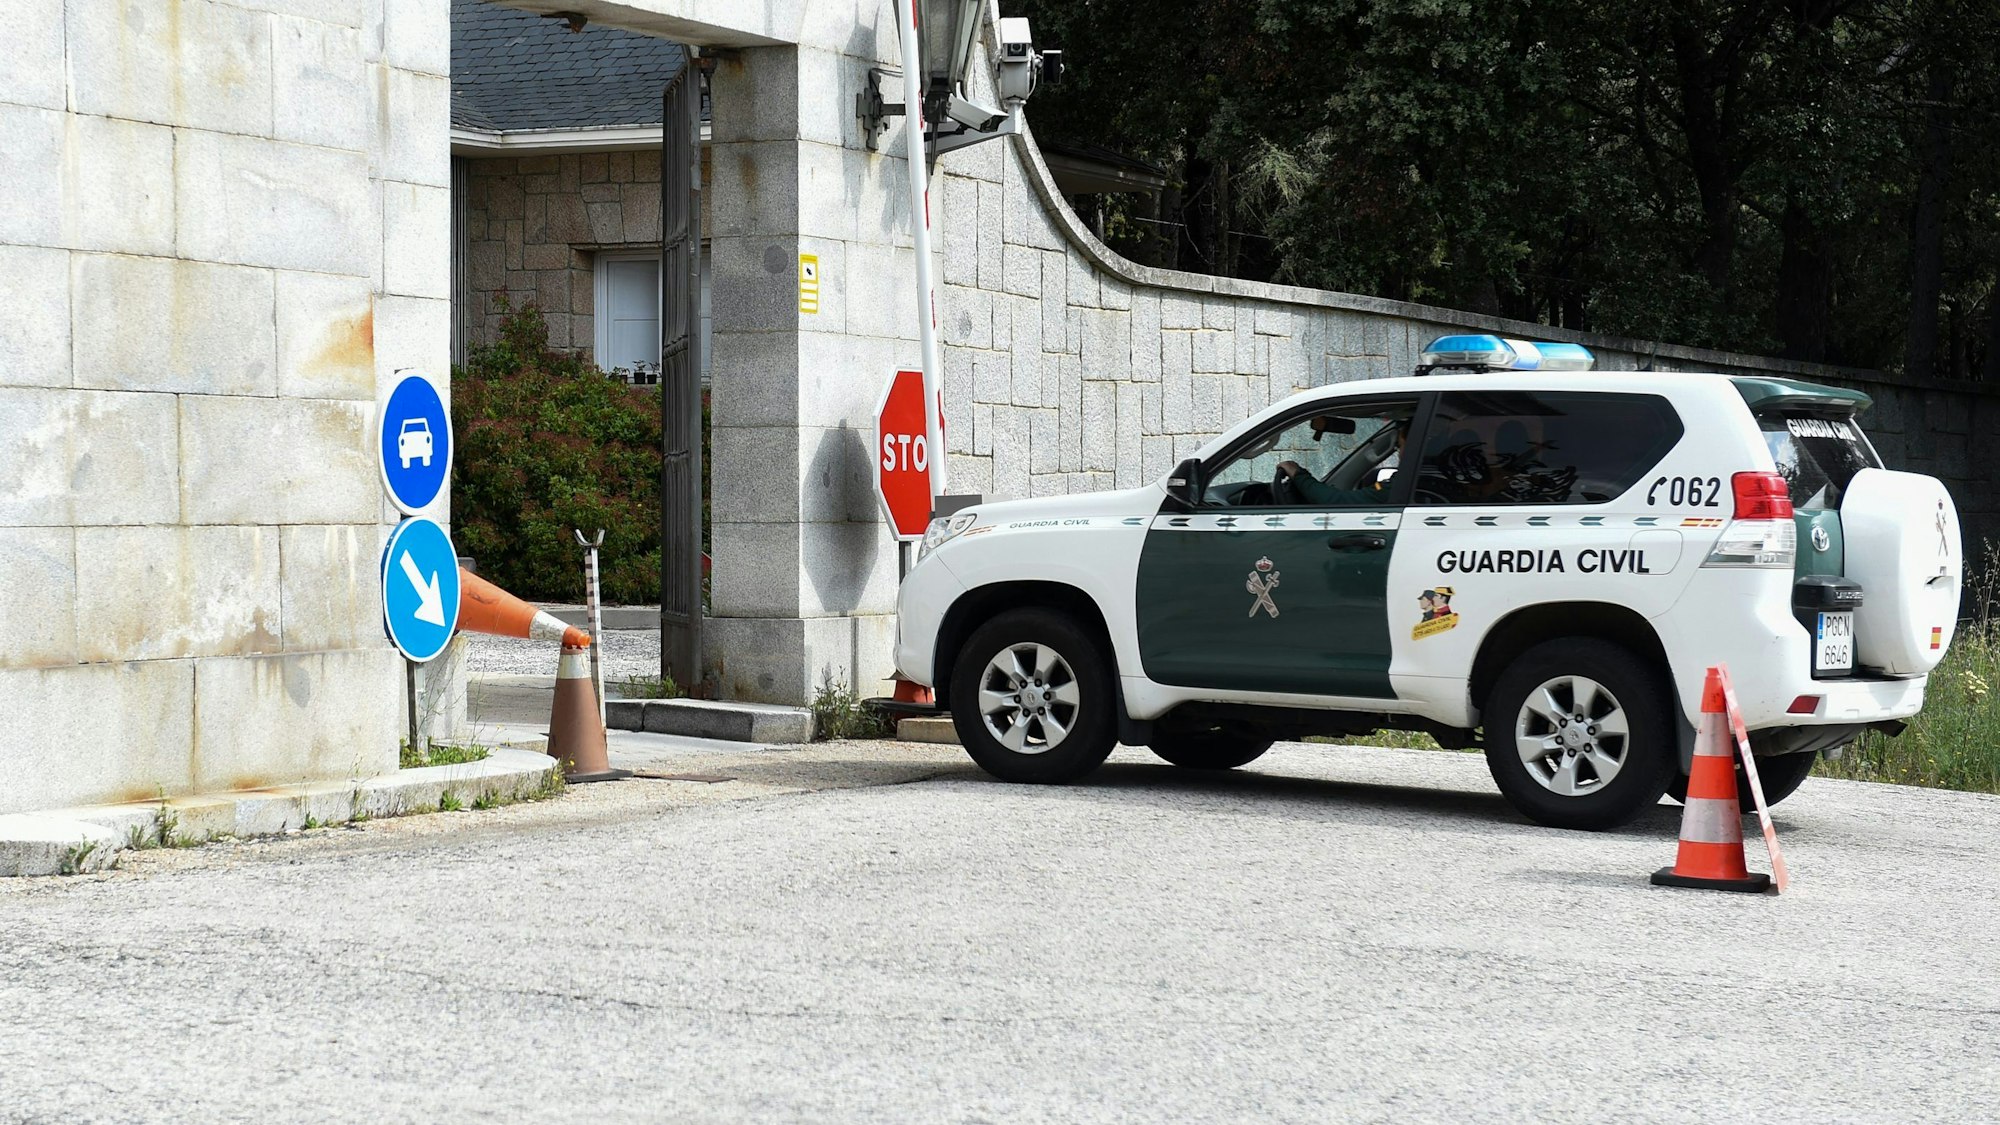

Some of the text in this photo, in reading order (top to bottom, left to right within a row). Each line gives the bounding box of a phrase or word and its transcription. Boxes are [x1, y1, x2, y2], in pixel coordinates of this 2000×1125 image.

[1786, 419, 1857, 441] GUARDIA CIVIL
[882, 433, 928, 472] STO
[1669, 476, 1721, 507] 062
[1009, 518, 1090, 529] GUARDIA CIVIL
[1437, 549, 1650, 573] GUARDIA CIVIL
[1825, 615, 1850, 636] PGCN
[1824, 645, 1848, 665] 6646
